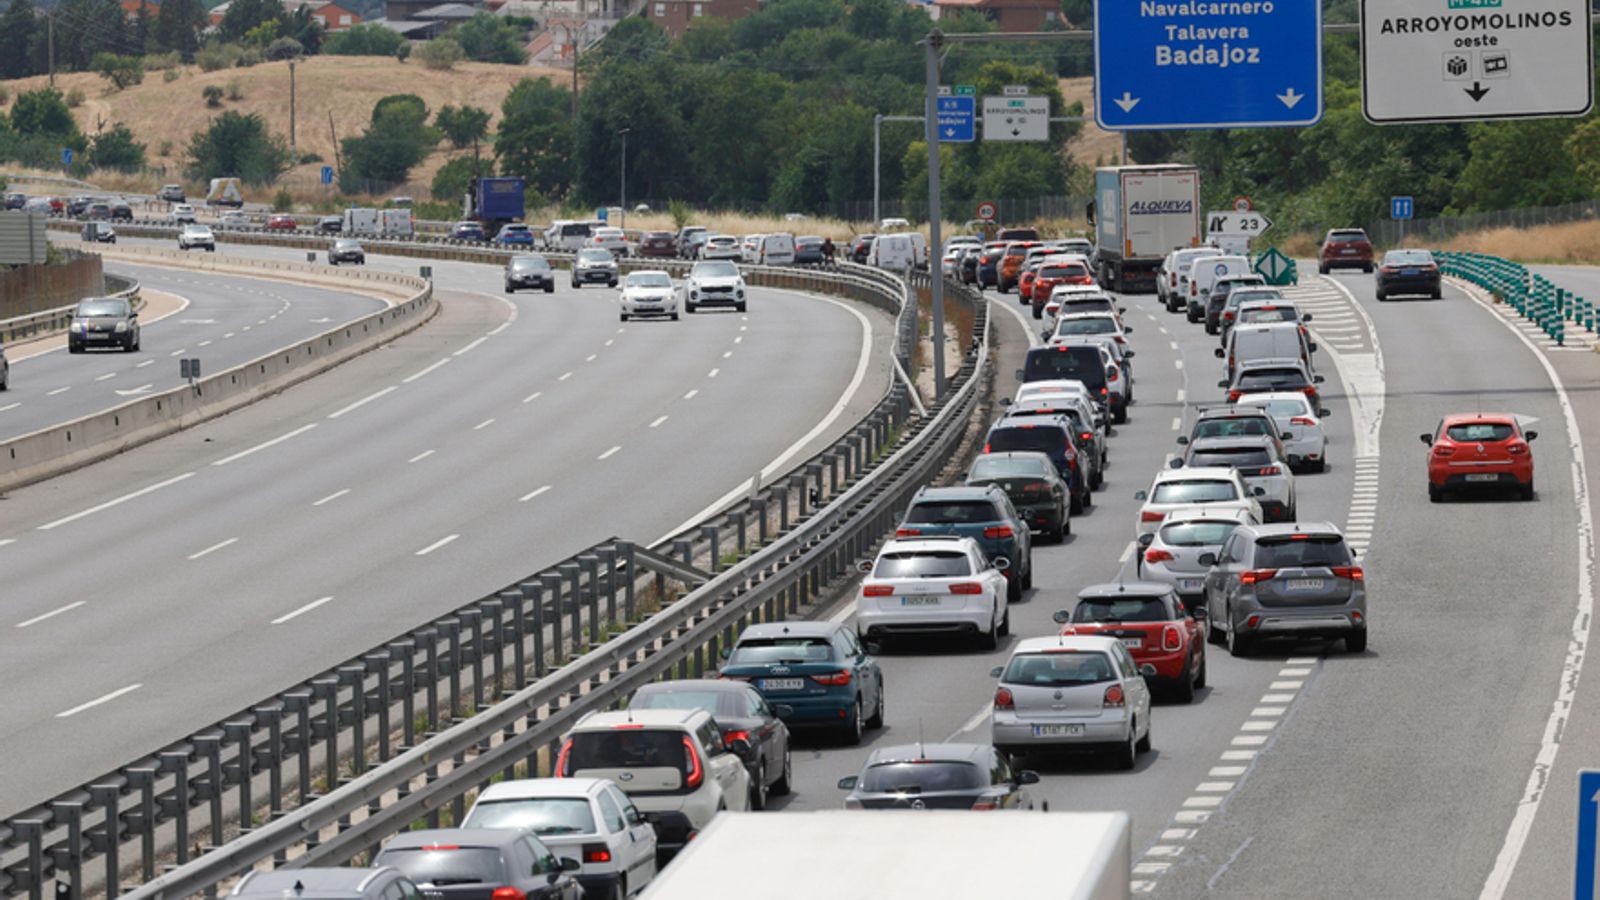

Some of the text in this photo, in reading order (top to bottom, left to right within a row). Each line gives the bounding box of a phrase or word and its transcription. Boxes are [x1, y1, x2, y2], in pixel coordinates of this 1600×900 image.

[1140, 0, 1274, 16] Navalcarnero
[1381, 11, 1572, 34] ARROYOMOLINOS
[1165, 25, 1249, 40] Talavera
[1454, 34, 1498, 47] oeste
[1156, 43, 1260, 67] Badajoz
[1130, 200, 1192, 212] ALQUEVA
[1240, 219, 1258, 230] 23
